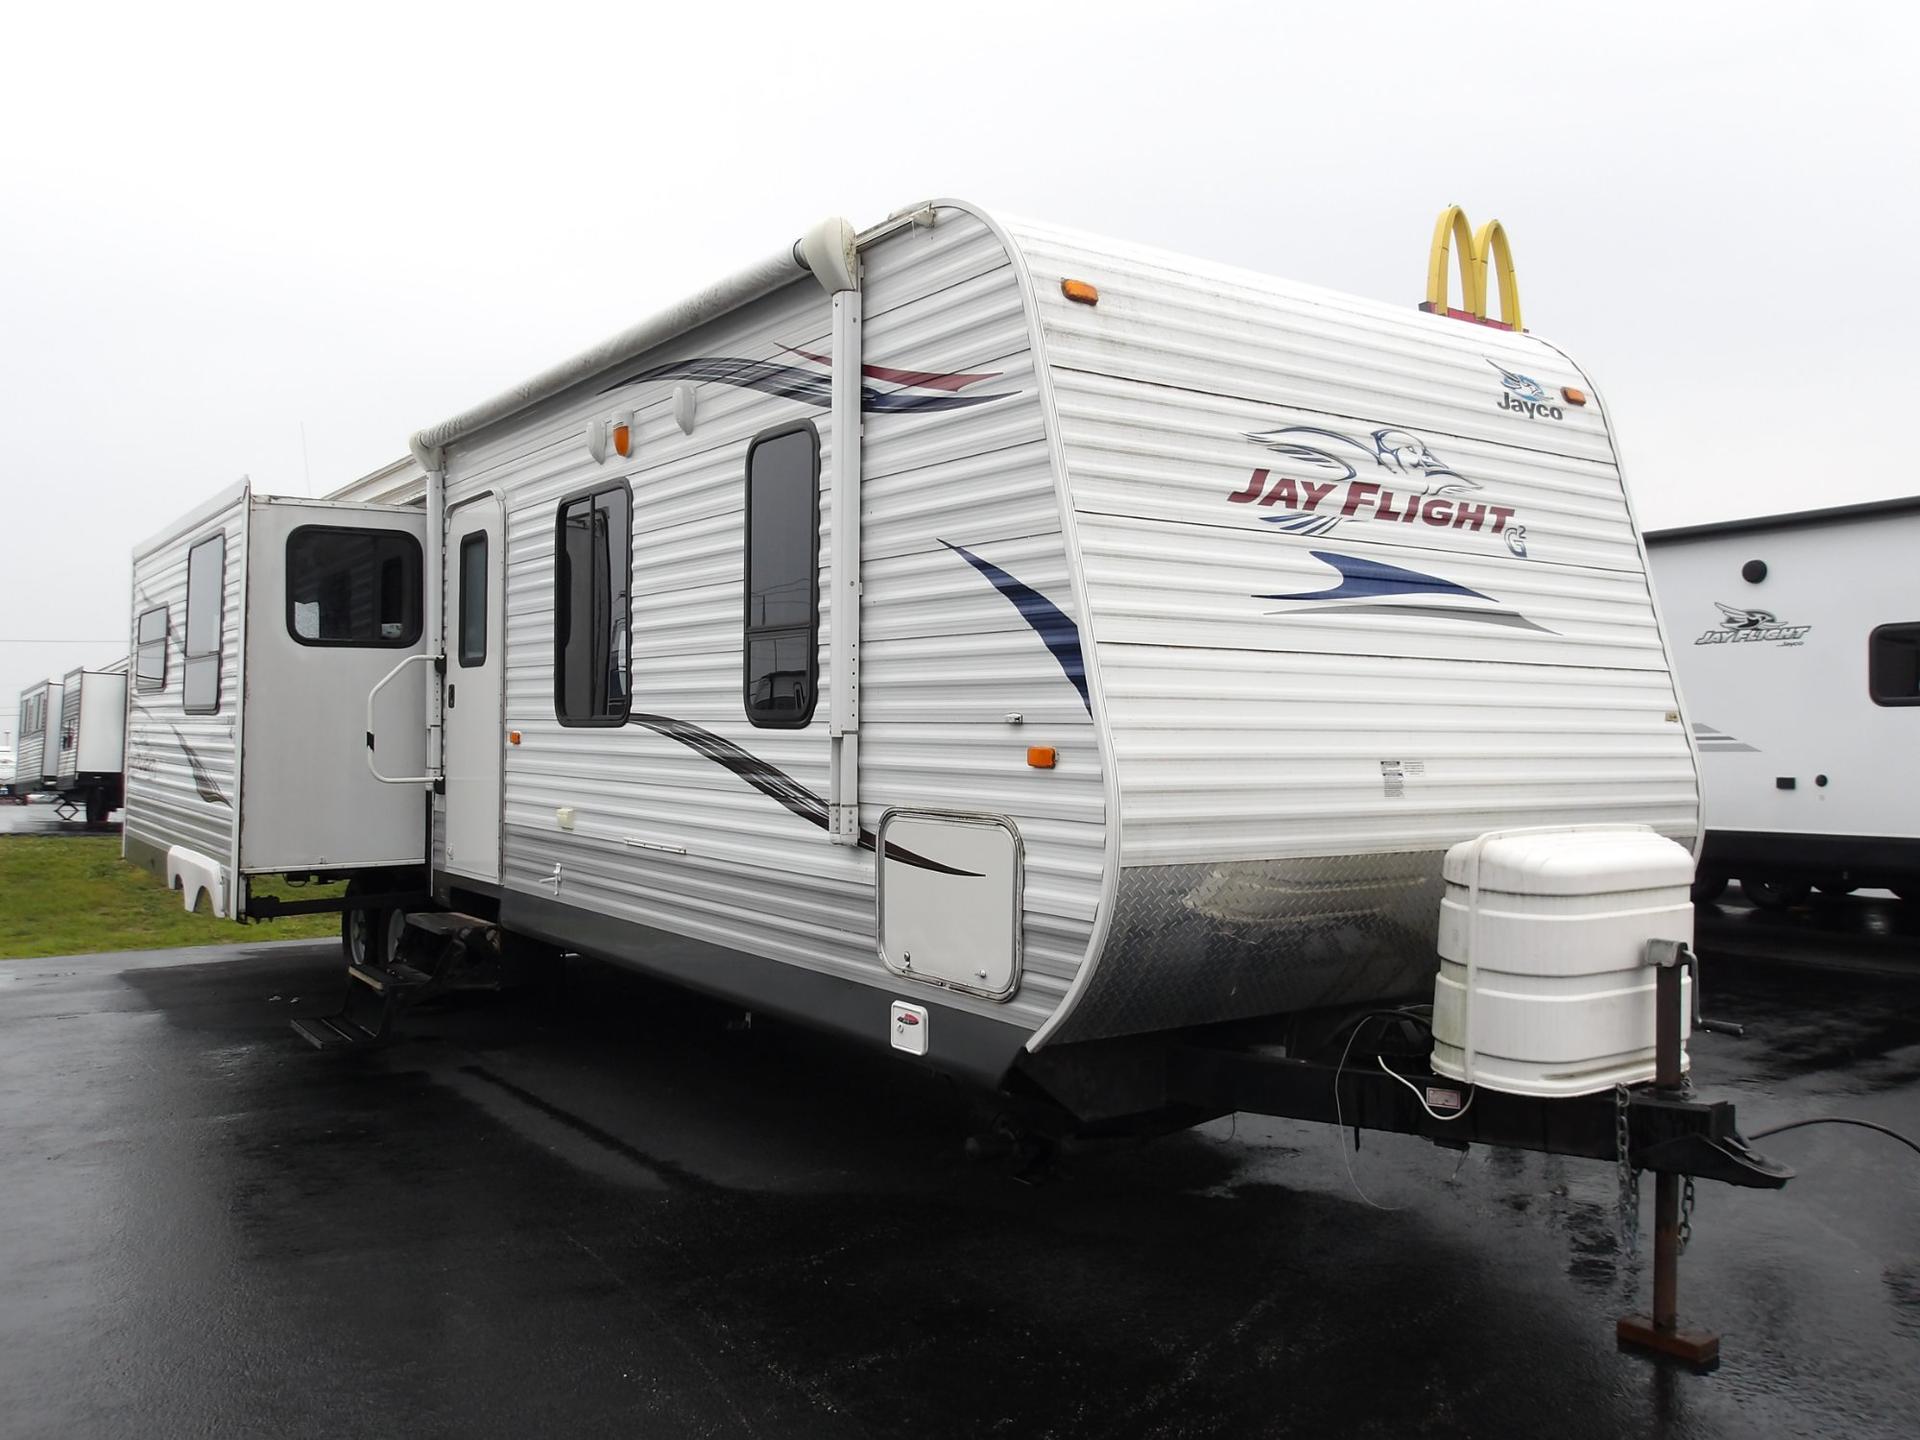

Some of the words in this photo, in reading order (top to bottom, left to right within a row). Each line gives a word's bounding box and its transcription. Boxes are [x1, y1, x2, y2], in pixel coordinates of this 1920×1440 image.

[1497, 391, 1563, 421] Jayco
[1227, 468, 1338, 511] JAY
[1340, 481, 1515, 534] FLIGHT
[1693, 630, 1737, 645] JAY
[1731, 625, 1812, 643] FLIGHT
